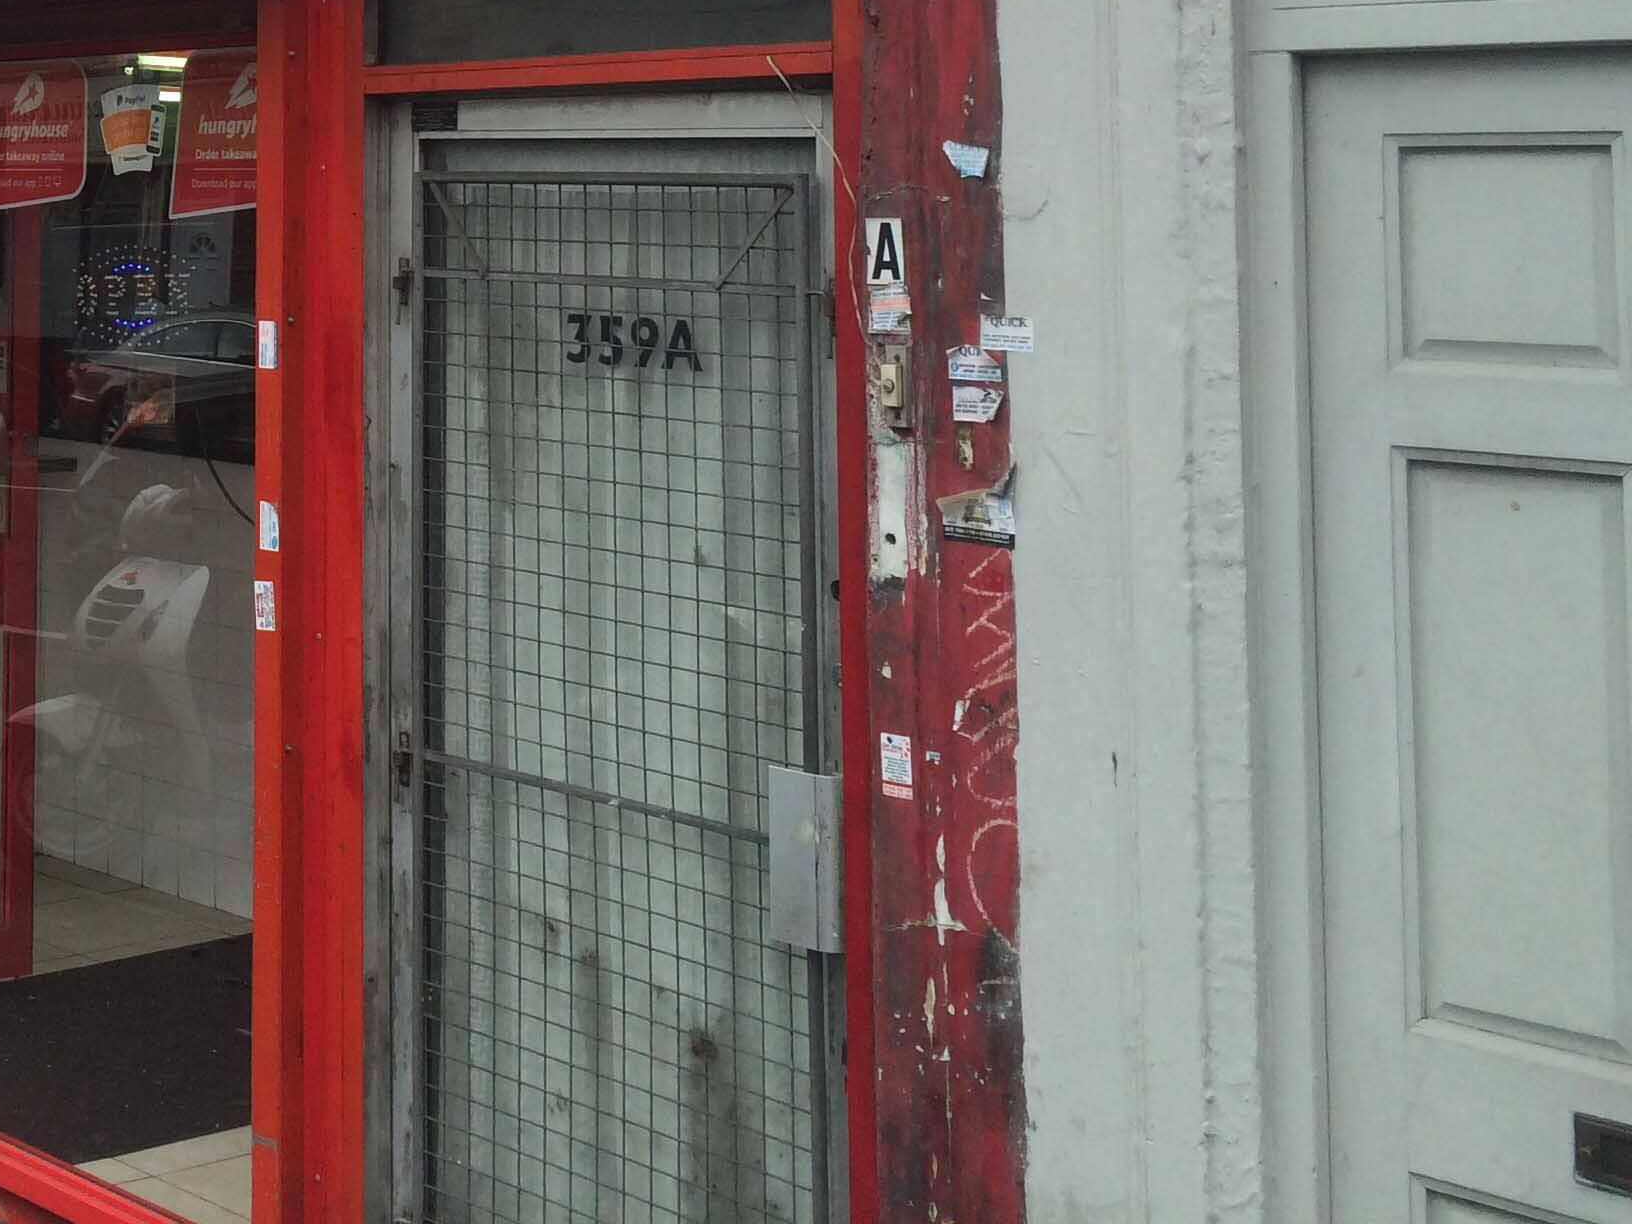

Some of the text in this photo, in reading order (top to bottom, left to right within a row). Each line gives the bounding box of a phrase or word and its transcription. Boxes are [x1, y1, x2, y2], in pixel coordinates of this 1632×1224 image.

[198, 114, 256, 139] hungry
[195, 149, 219, 160] Order
[872, 222, 901, 280] A
[990, 317, 1030, 328] QUICK
[567, 314, 704, 372] 359A
